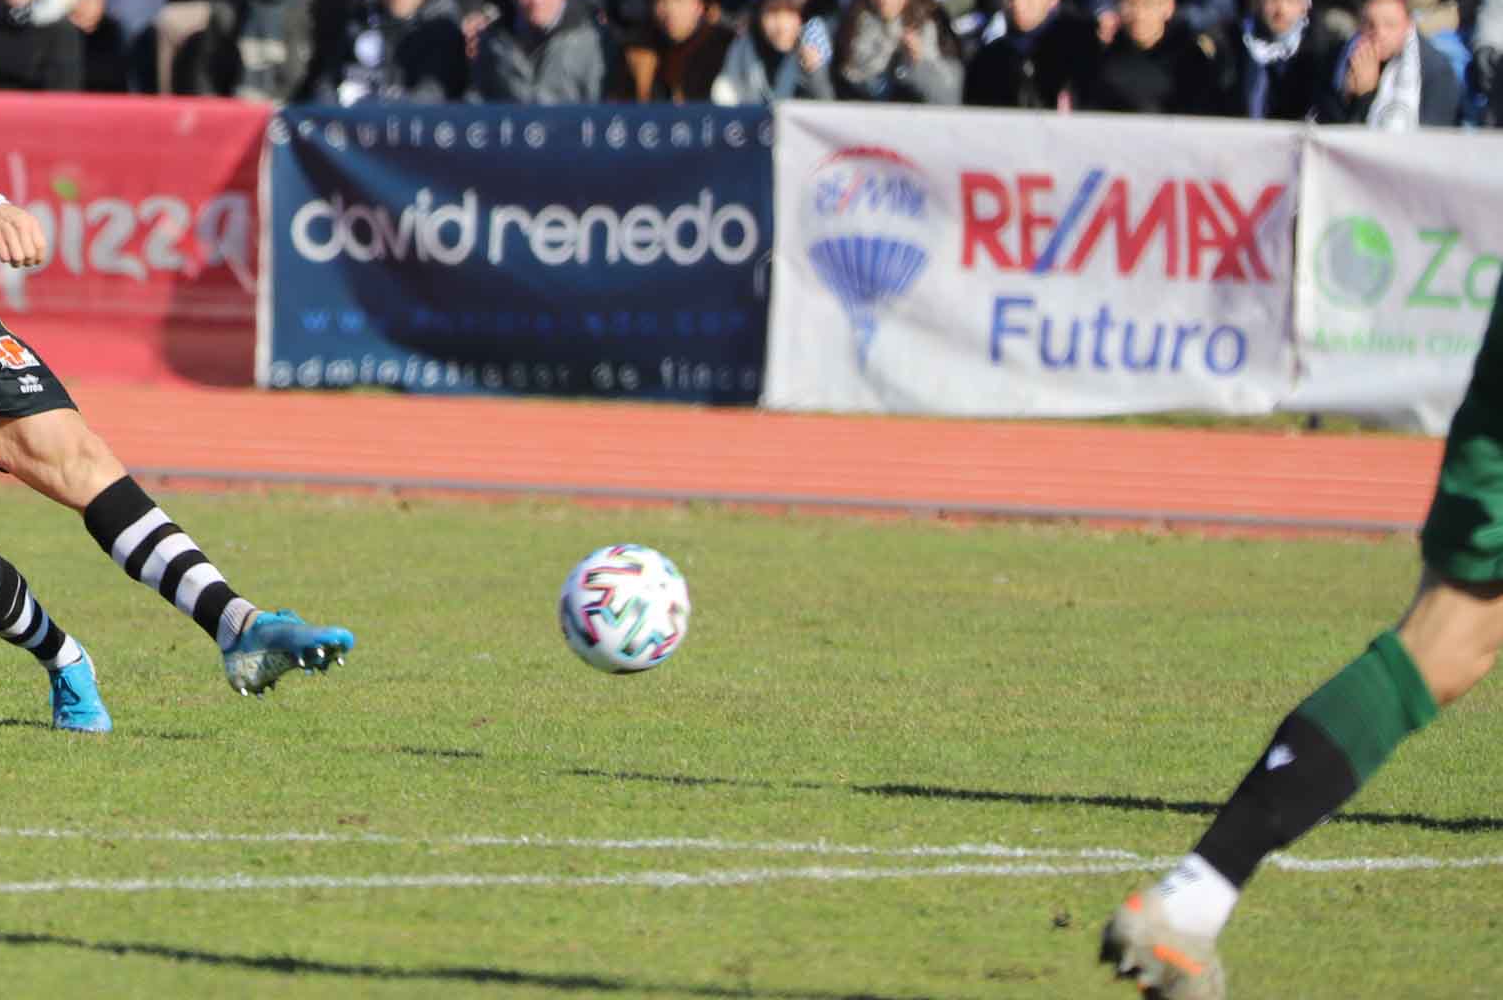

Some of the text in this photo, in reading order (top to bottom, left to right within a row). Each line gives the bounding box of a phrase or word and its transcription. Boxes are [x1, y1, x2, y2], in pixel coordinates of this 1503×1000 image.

[290, 186, 760, 266] david renedo
[959, 168, 1288, 283] RE/MAX
[988, 293, 1249, 377] Futuro
